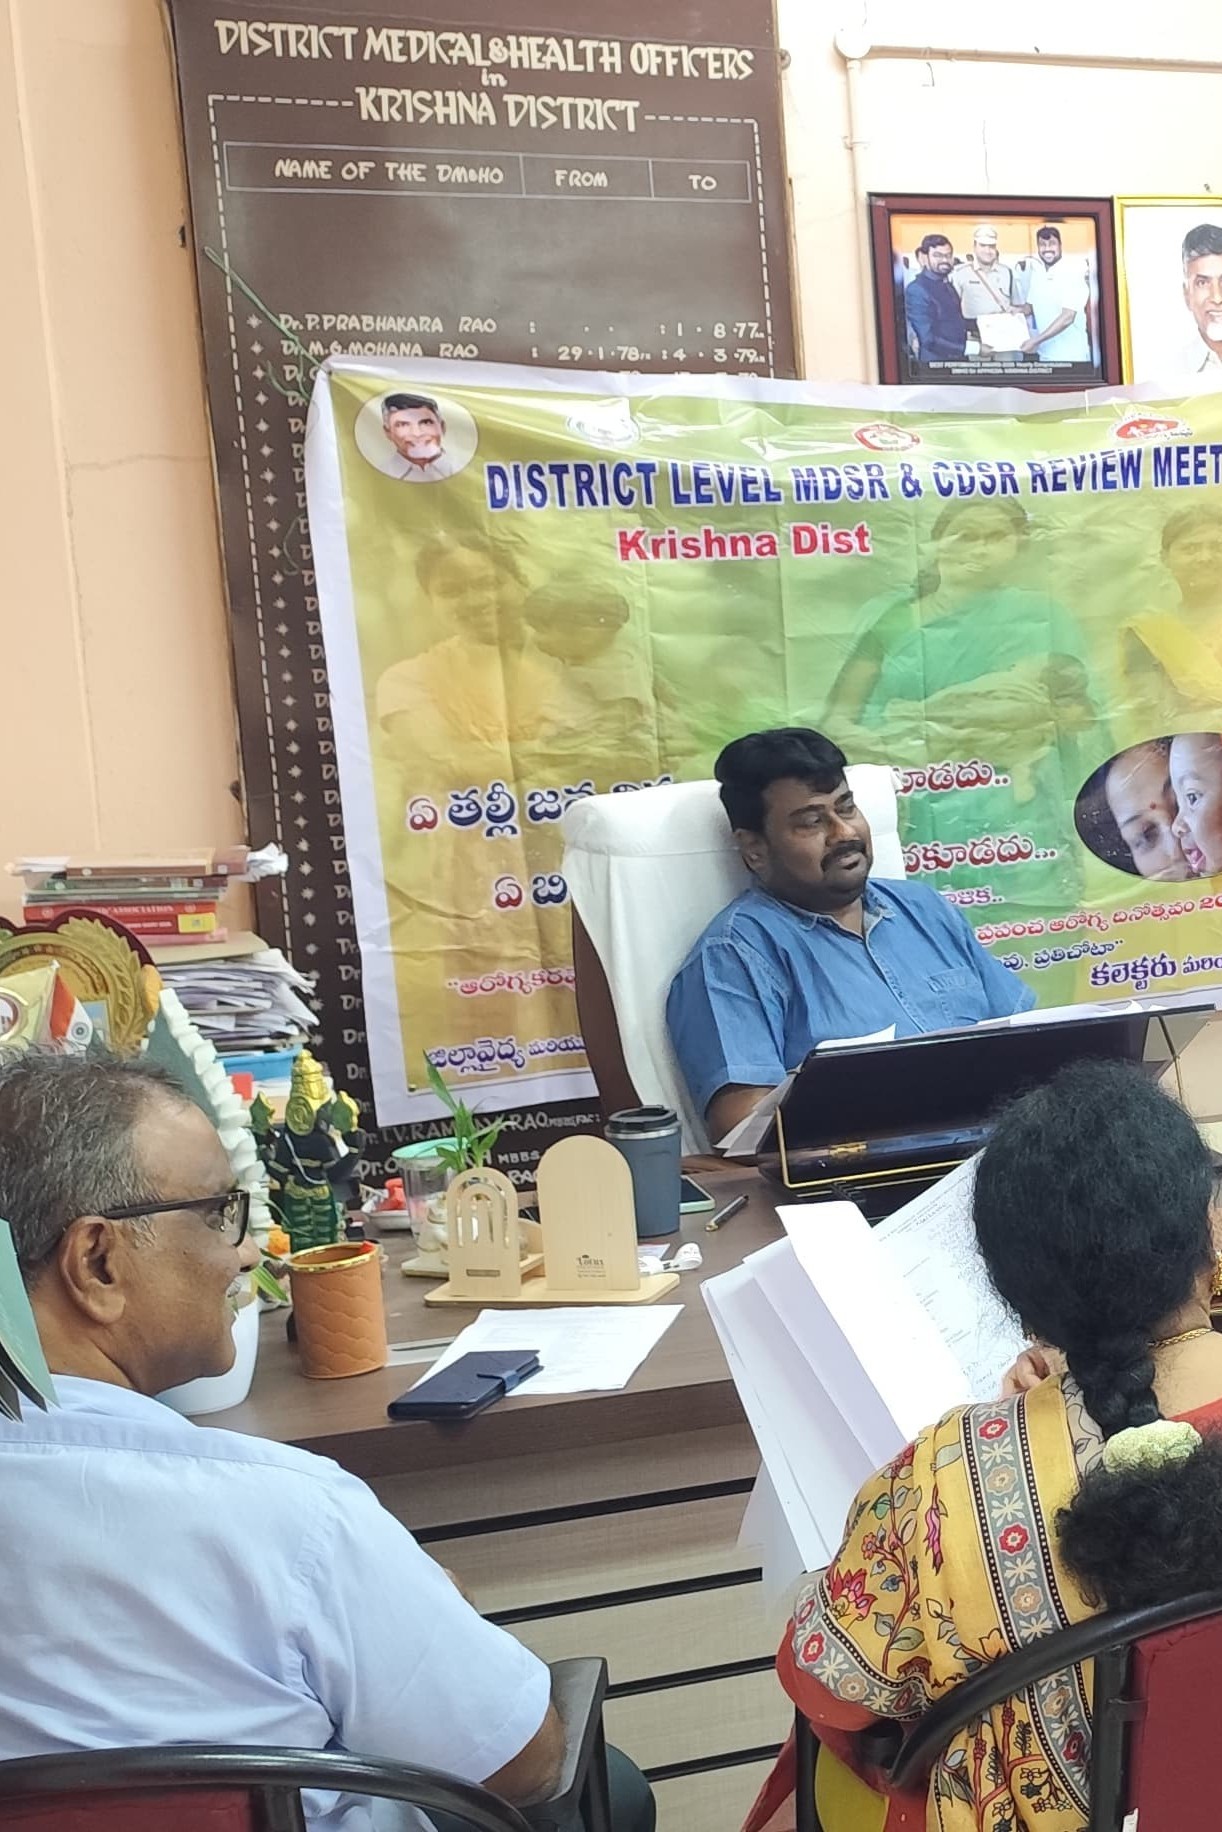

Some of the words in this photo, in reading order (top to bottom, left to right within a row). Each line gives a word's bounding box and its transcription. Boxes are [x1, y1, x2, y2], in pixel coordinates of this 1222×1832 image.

[214, 18, 359, 60] DISTRICT
[630, 42, 754, 80] OFFICERS
[481, 68, 507, 87] in
[355, 86, 497, 125] KRISHNA
[502, 94, 640, 132] DISTRICT
[274, 158, 332, 179] NAME
[341, 161, 375, 180] OF
[385, 162, 427, 182] THE
[555, 169, 608, 187] FROM
[688, 174, 717, 190] TO
[458, 316, 497, 334] RAO
[439, 343, 479, 359] RAO
[486, 461, 657, 509] DISTRICT
[670, 461, 782, 505] LEVEL
[791, 463, 889, 502] MDSR
[900, 464, 922, 499] &
[932, 460, 1019, 498] CDSR
[1030, 447, 1142, 493] REVIEW
[619, 528, 777, 560] Krishna
[793, 523, 870, 555] Dist
[409, 798, 438, 831] ఏ
[495, 876, 523, 908] ఏ
